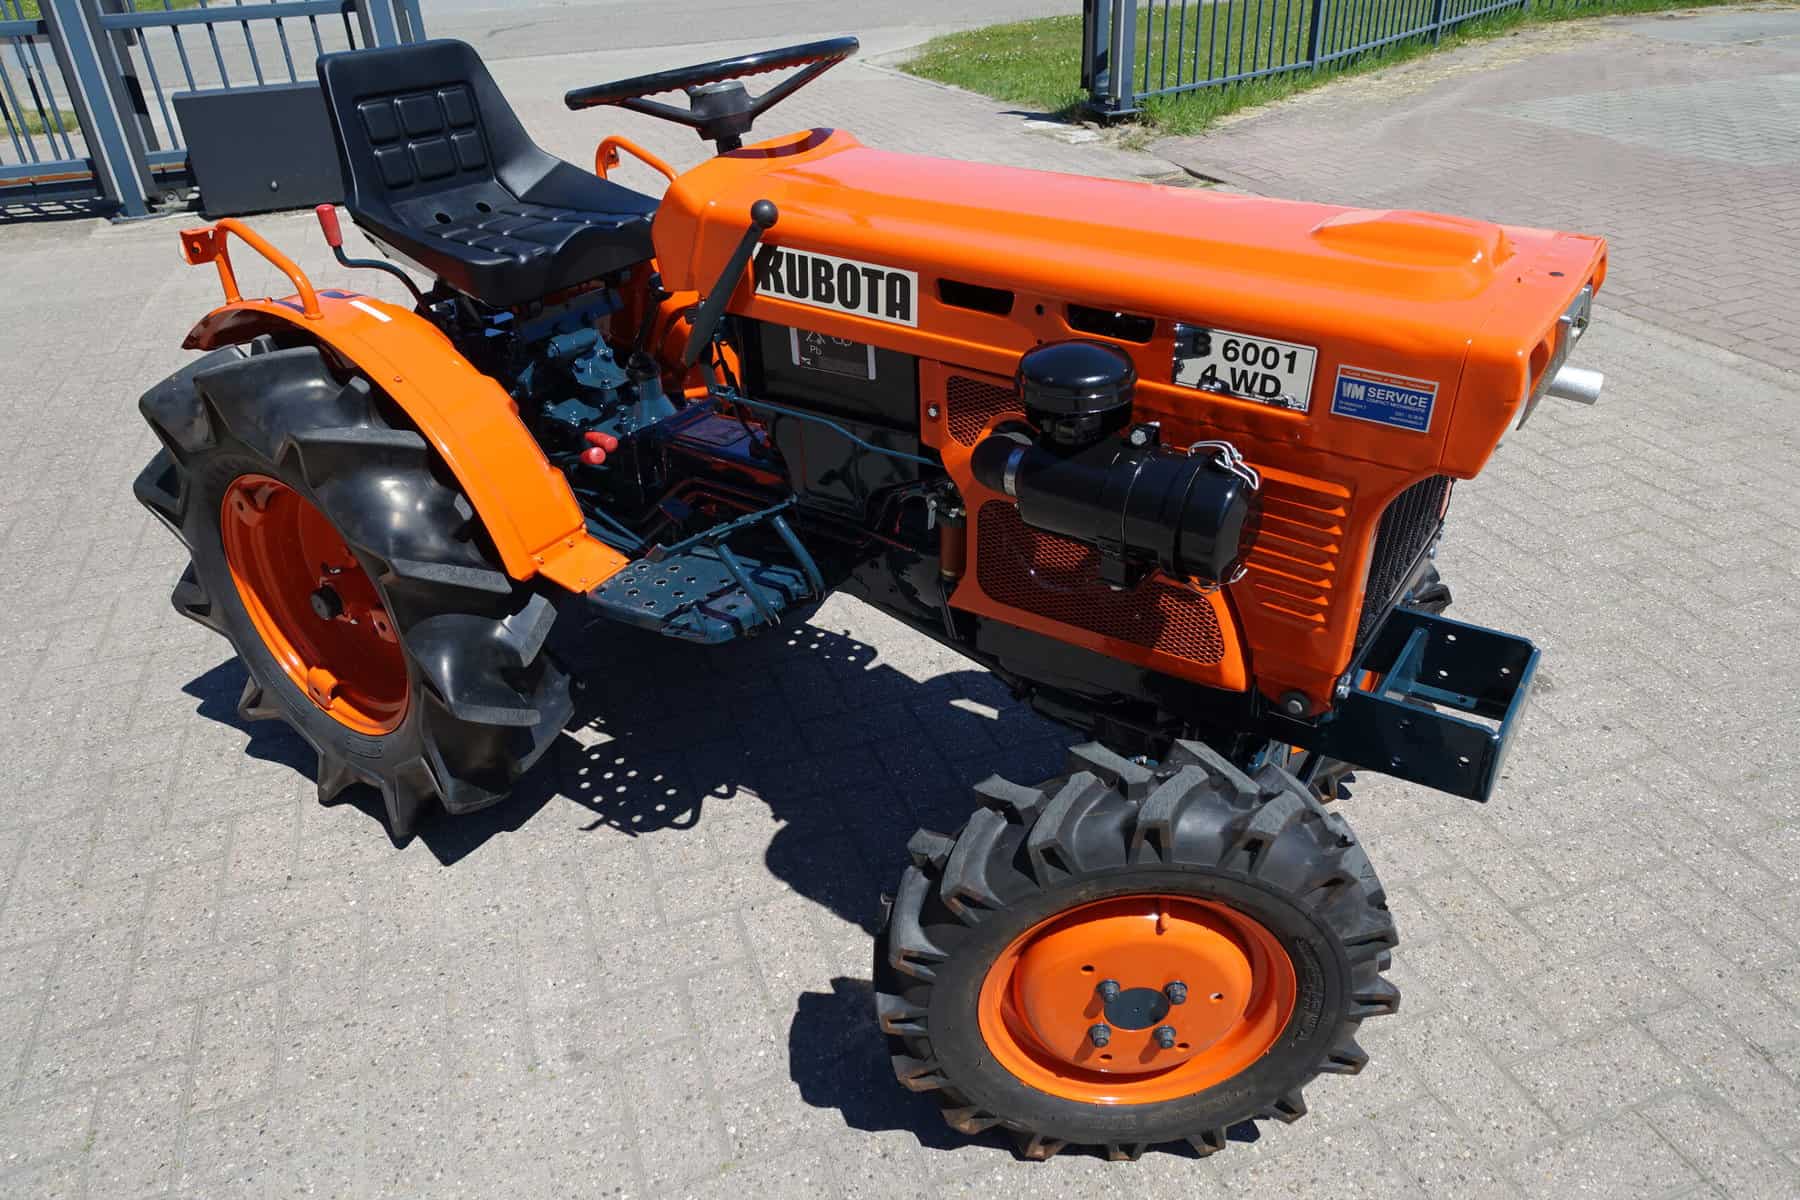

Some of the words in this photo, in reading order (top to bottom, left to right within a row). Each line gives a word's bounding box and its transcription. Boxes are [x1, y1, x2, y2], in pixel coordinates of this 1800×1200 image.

[759, 248, 912, 321] KUBOTA
[1192, 331, 1212, 358] B
[1222, 338, 1298, 374] 6001
[1200, 363, 1217, 386] 4
[1230, 366, 1282, 398] WD
[1367, 386, 1429, 408] SERVICE
